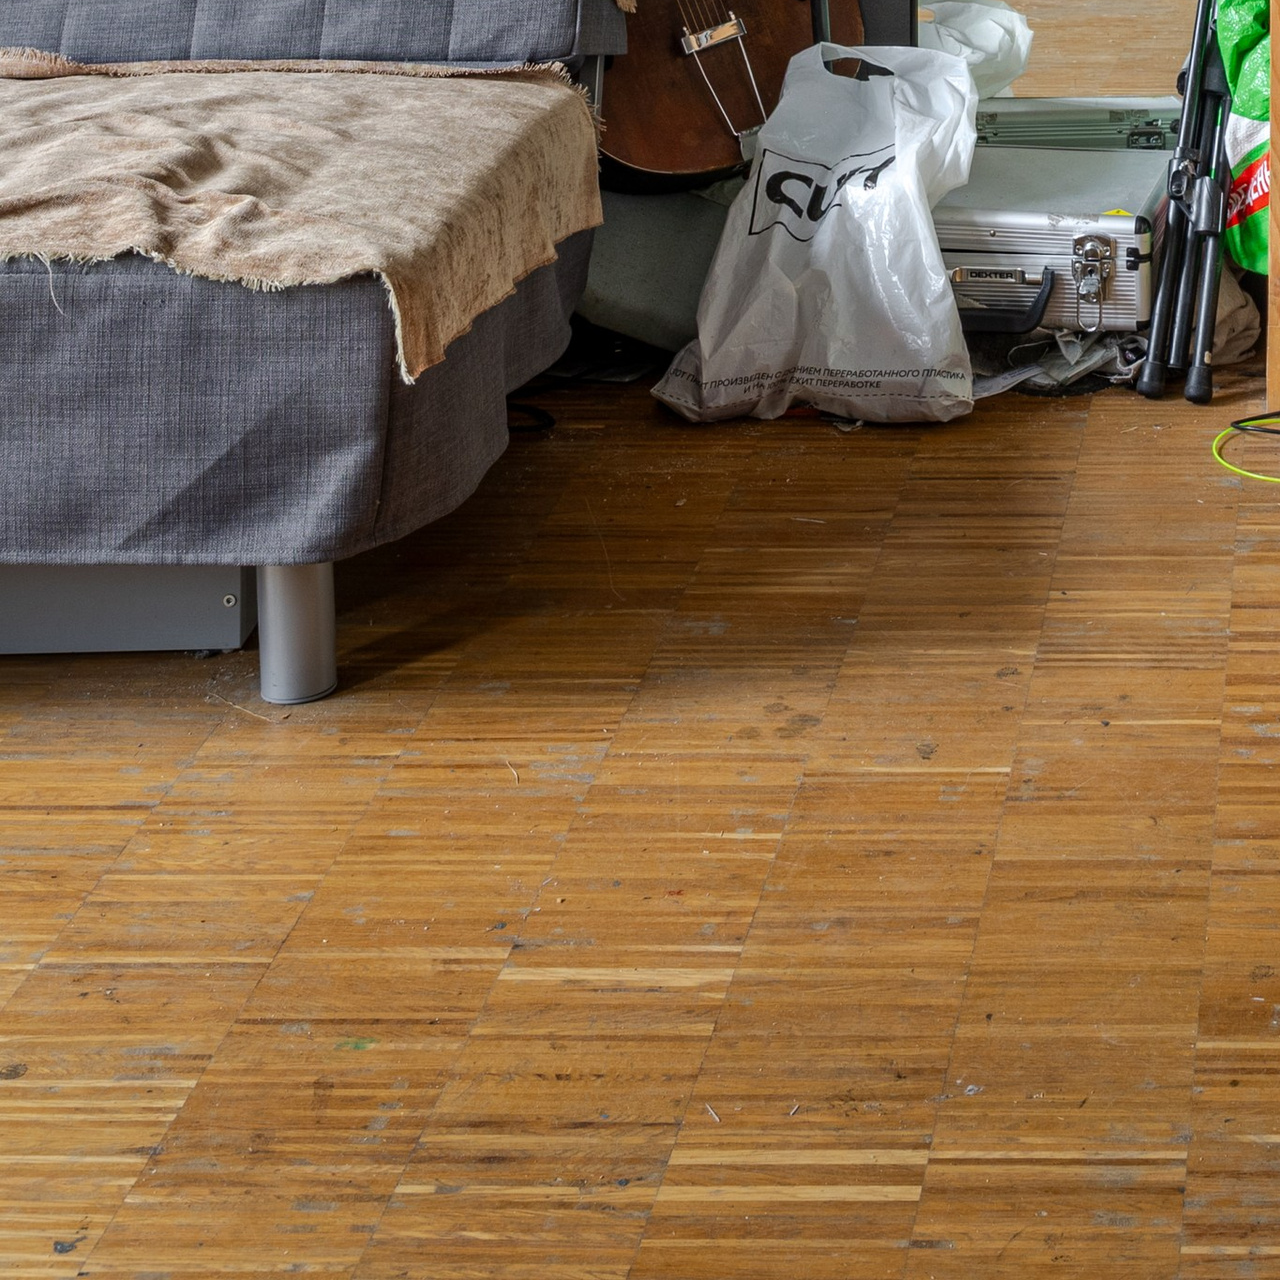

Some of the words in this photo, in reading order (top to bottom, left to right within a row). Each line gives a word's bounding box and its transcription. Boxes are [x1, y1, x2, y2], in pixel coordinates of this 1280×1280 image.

[970, 271, 1013, 279] DEXTER
[823, 368, 919, 379] ПЕРЕРАБОТАННОГО
[921, 368, 966, 380] ПЛАСТИКА
[815, 379, 881, 389] ПЕРЕРАБОТКЕ
